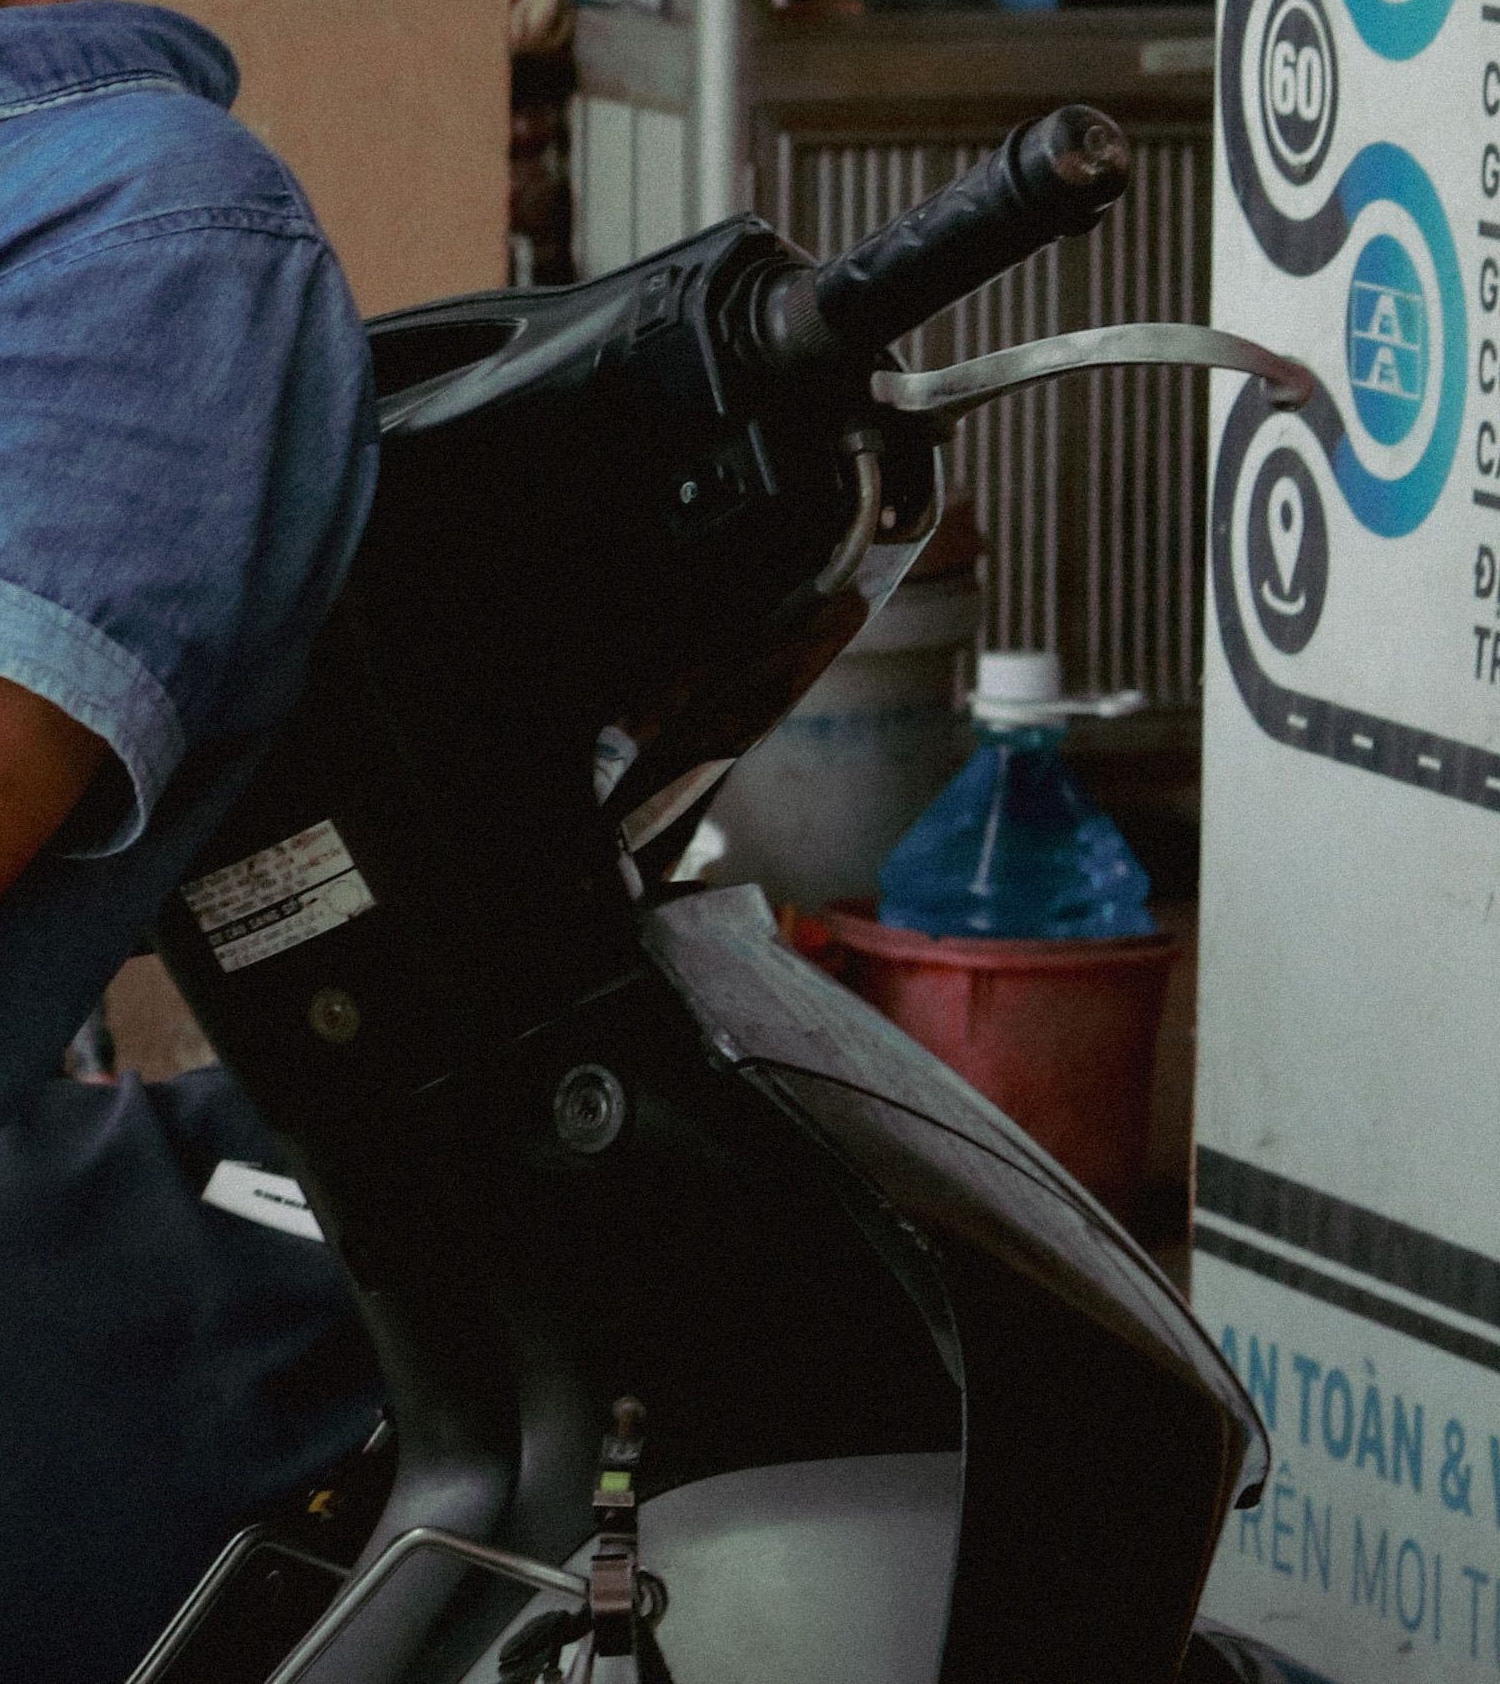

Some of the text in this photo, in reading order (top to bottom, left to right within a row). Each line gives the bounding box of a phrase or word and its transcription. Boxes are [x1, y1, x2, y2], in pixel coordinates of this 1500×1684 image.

[1269, 38, 1324, 124] 60
[1293, 1351, 1426, 1492] TOÀN
[1439, 1417, 1473, 1516] &
[1237, 1459, 1332, 1593] RÊN
